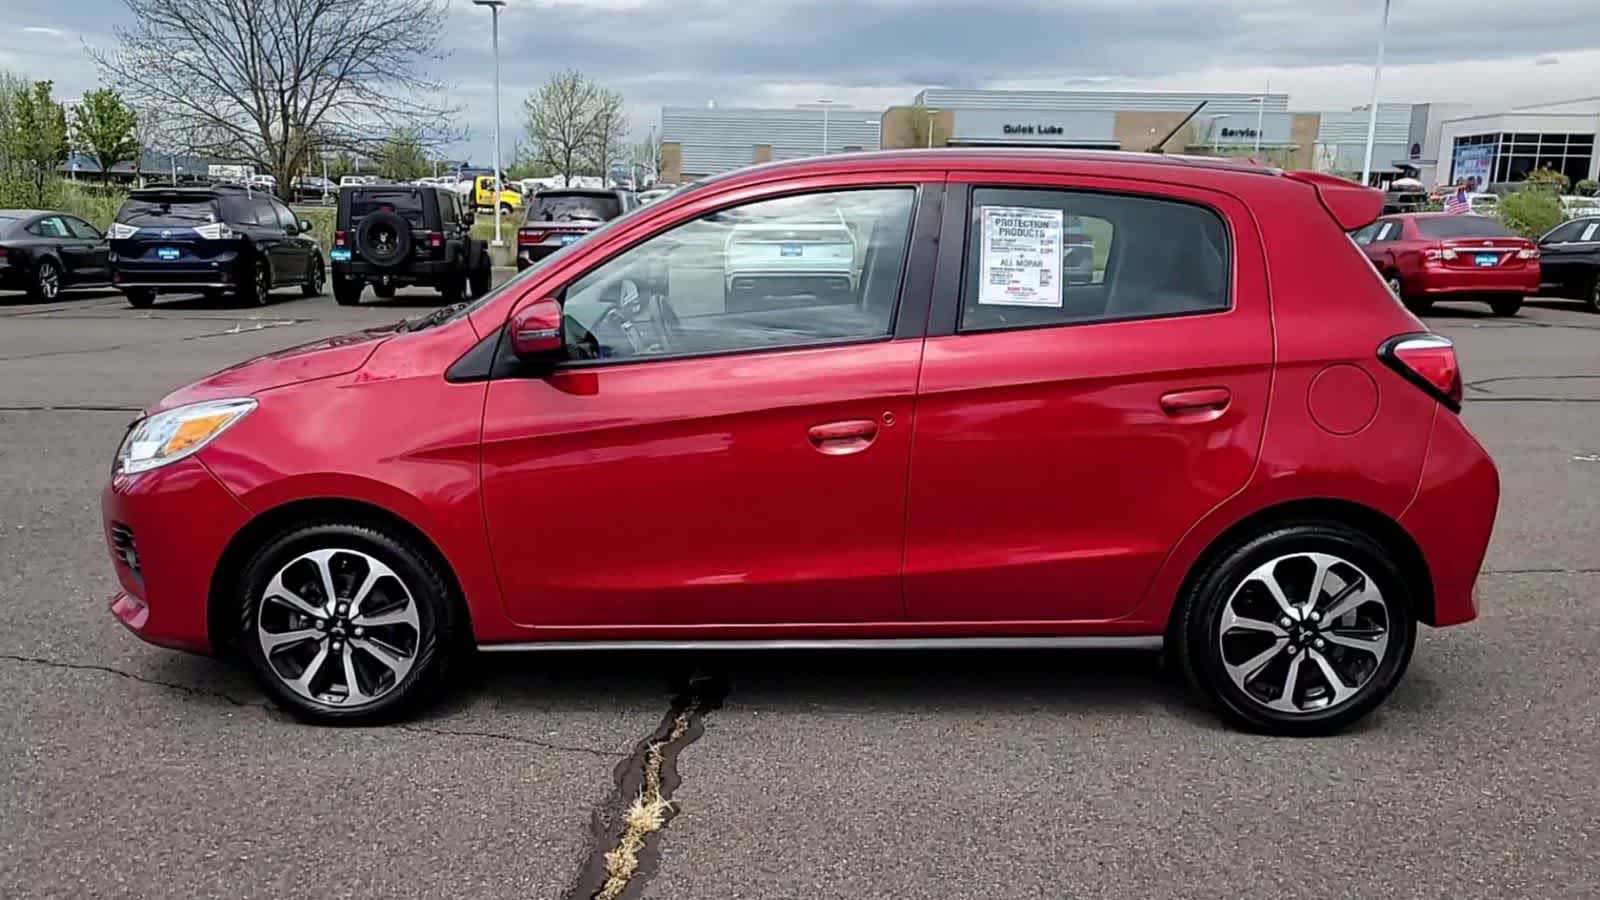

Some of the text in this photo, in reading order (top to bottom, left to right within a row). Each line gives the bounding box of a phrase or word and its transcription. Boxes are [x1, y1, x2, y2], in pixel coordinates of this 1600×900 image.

[1003, 124, 1064, 134] Quick Lube
[995, 218, 1049, 229] PROTECTION
[999, 228, 1046, 238] PRODUCTS
[1000, 259, 1014, 267] ALL
